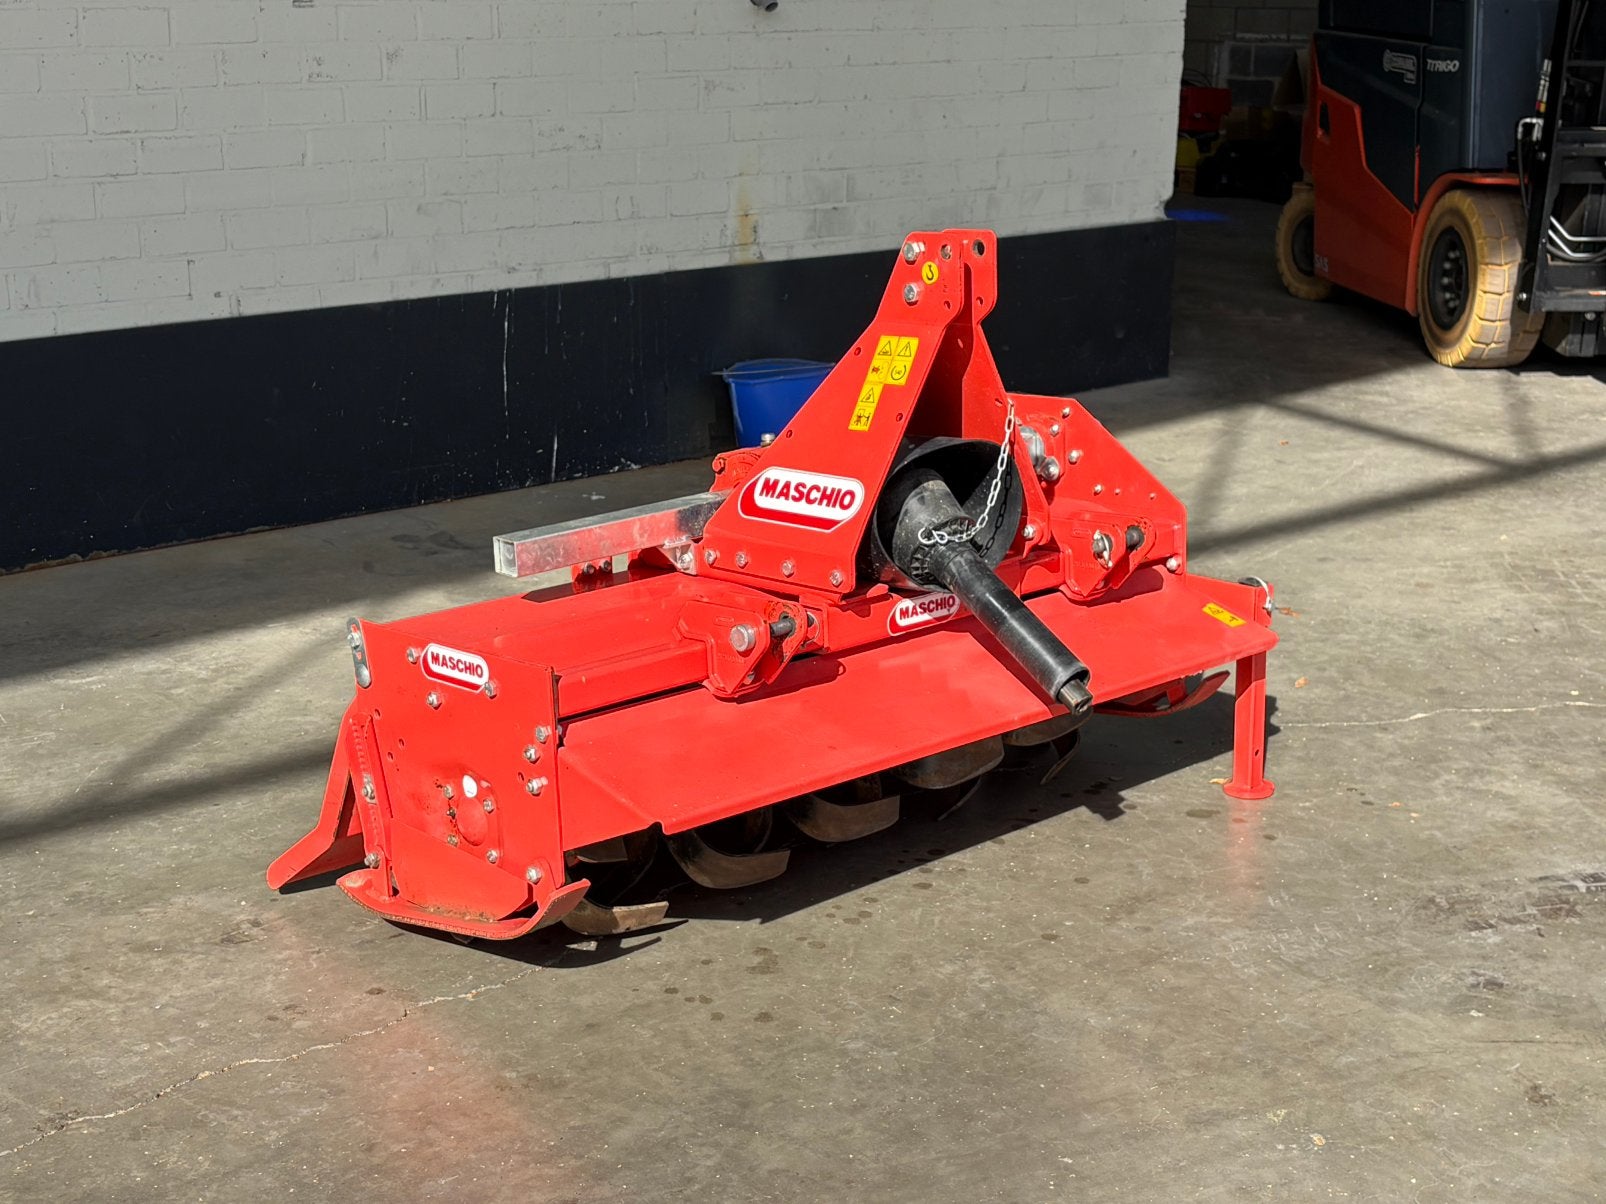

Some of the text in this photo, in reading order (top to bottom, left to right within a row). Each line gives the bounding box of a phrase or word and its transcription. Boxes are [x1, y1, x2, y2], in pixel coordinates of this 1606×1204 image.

[759, 477, 856, 511] MASCHIO
[899, 594, 956, 621] MASCHIO
[430, 651, 484, 679] MASCHIO
